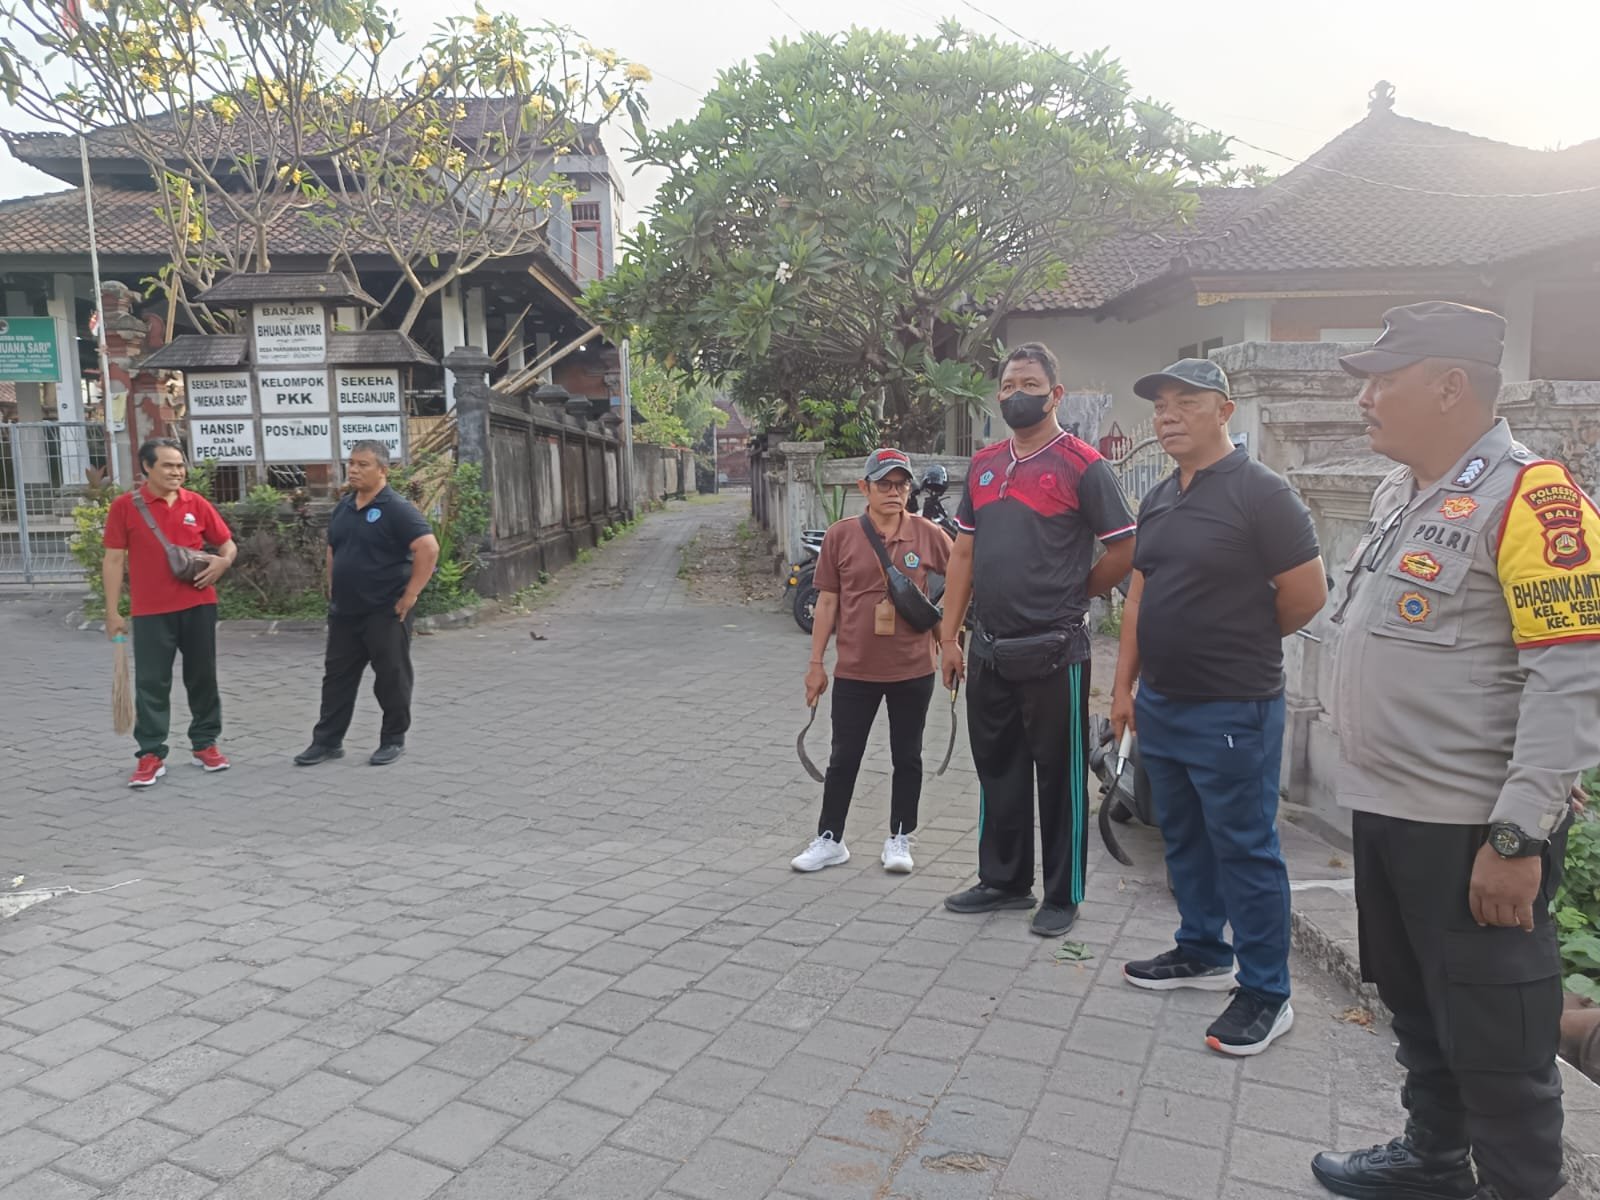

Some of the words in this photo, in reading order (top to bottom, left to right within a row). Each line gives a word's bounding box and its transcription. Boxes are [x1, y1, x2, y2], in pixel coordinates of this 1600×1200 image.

[262, 306, 315, 316] BANJAR
[258, 324, 293, 337] BHUANA
[294, 323, 322, 336] ANYAR
[0, 342, 26, 354] UANA
[192, 380, 219, 390] SEKEHA
[220, 379, 248, 389] TERUNA
[261, 377, 324, 388] KELOMPOK
[341, 376, 394, 386] SEKEHA
[276, 392, 313, 405] PKK
[340, 391, 396, 404] BLEGANJUR
[200, 423, 245, 435] HANSIP
[265, 424, 328, 437] POSYANDU
[342, 423, 373, 433] SEKEHA
[374, 423, 398, 433] CANTI
[196, 446, 253, 458] PECALANG
[1529, 486, 1578, 502] POLRESTA
[1544, 509, 1577, 520] BALI
[1413, 524, 1471, 552] POLRI
[1512, 573, 1600, 609] BHABINKAMT
[1532, 604, 1563, 619] KEL.
[1569, 599, 1600, 614] KESI
[1546, 616, 1575, 630] KEC.
[1579, 613, 1600, 627] DEN
